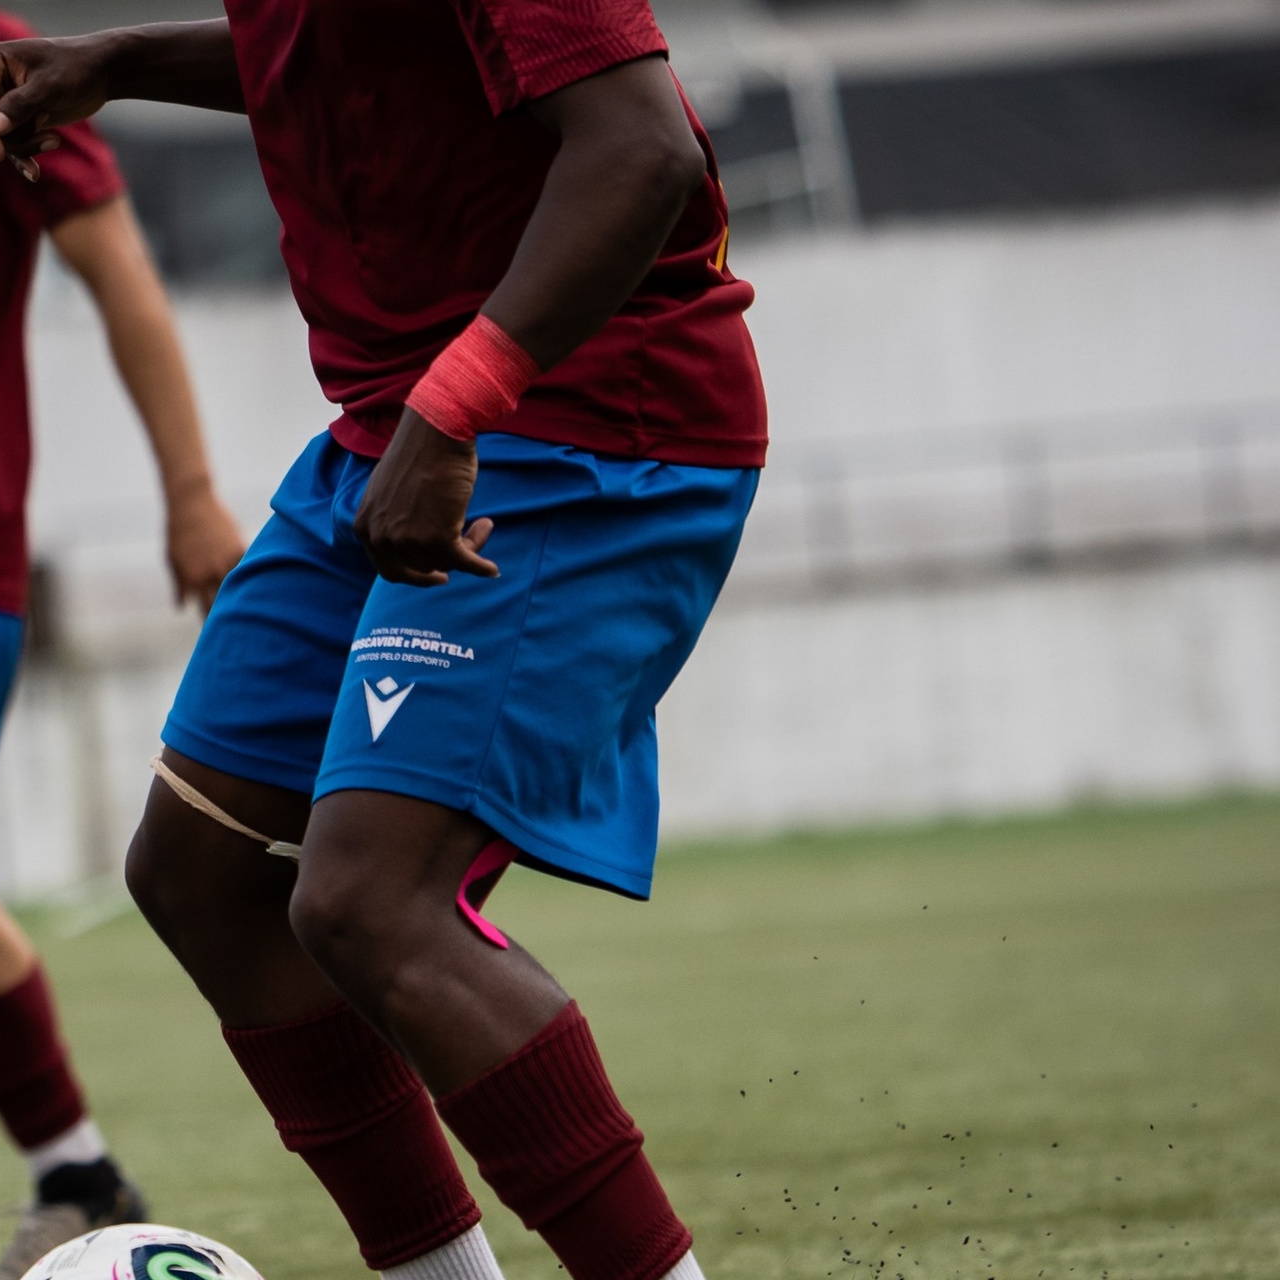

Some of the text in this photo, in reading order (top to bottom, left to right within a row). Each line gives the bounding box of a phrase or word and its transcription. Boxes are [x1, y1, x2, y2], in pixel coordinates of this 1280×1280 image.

[370, 627, 442, 640] JUNTA DE FREGUESIA
[411, 638, 475, 660] PORTELA
[355, 652, 451, 668] JUNTOS PELO DESPORTO
